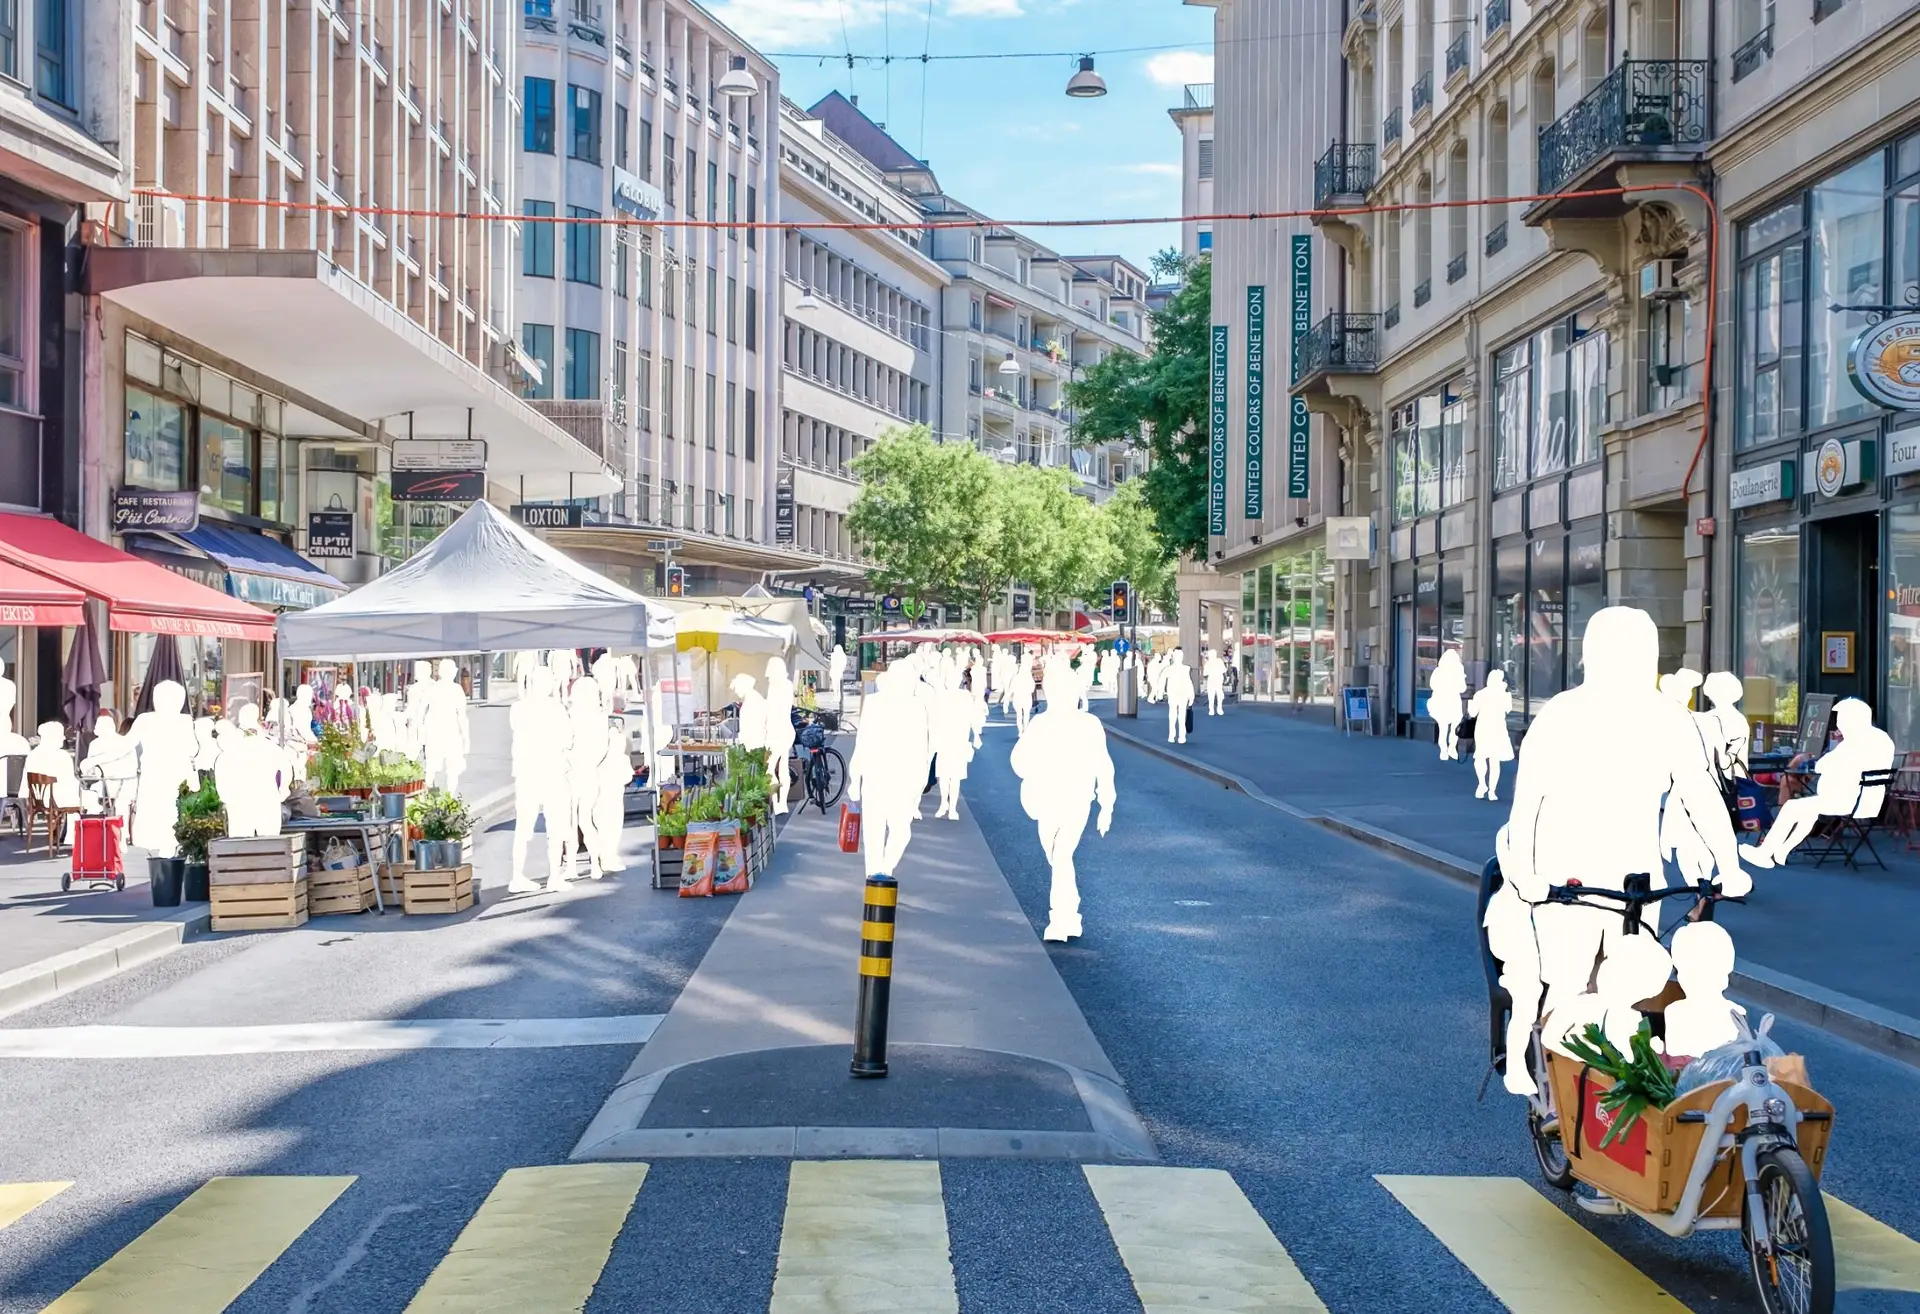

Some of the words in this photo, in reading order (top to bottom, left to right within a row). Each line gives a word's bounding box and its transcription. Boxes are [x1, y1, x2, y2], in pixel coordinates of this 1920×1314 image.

[619, 181, 663, 212] GLOBUS
[1295, 237, 1308, 331] BENETTON.
[1249, 287, 1262, 371] BENETTON.
[1876, 333, 1894, 348] Le
[1214, 327, 1226, 403] BENETTON.
[1249, 375, 1261, 395] OF
[1214, 406, 1225, 424] OF
[1249, 399, 1261, 456] COLORS
[1213, 427, 1224, 479] COLORS
[1293, 431, 1306, 494] UNITED
[1891, 443, 1918, 464] Four
[1248, 460, 1260, 516] UNITED
[1732, 472, 1779, 499] Boulangerie
[118, 497, 138, 506] CAFE
[142, 497, 194, 506] RESTAURANT
[779, 508, 790, 517] EF
[1212, 482, 1224, 532] UNITED
[144, 508, 194, 525] Central
[522, 508, 569, 526] LOXTON
[310, 546, 353, 556] CENTRAL
[312, 536, 323, 546] LE
[324, 536, 351, 546] P'TIT
